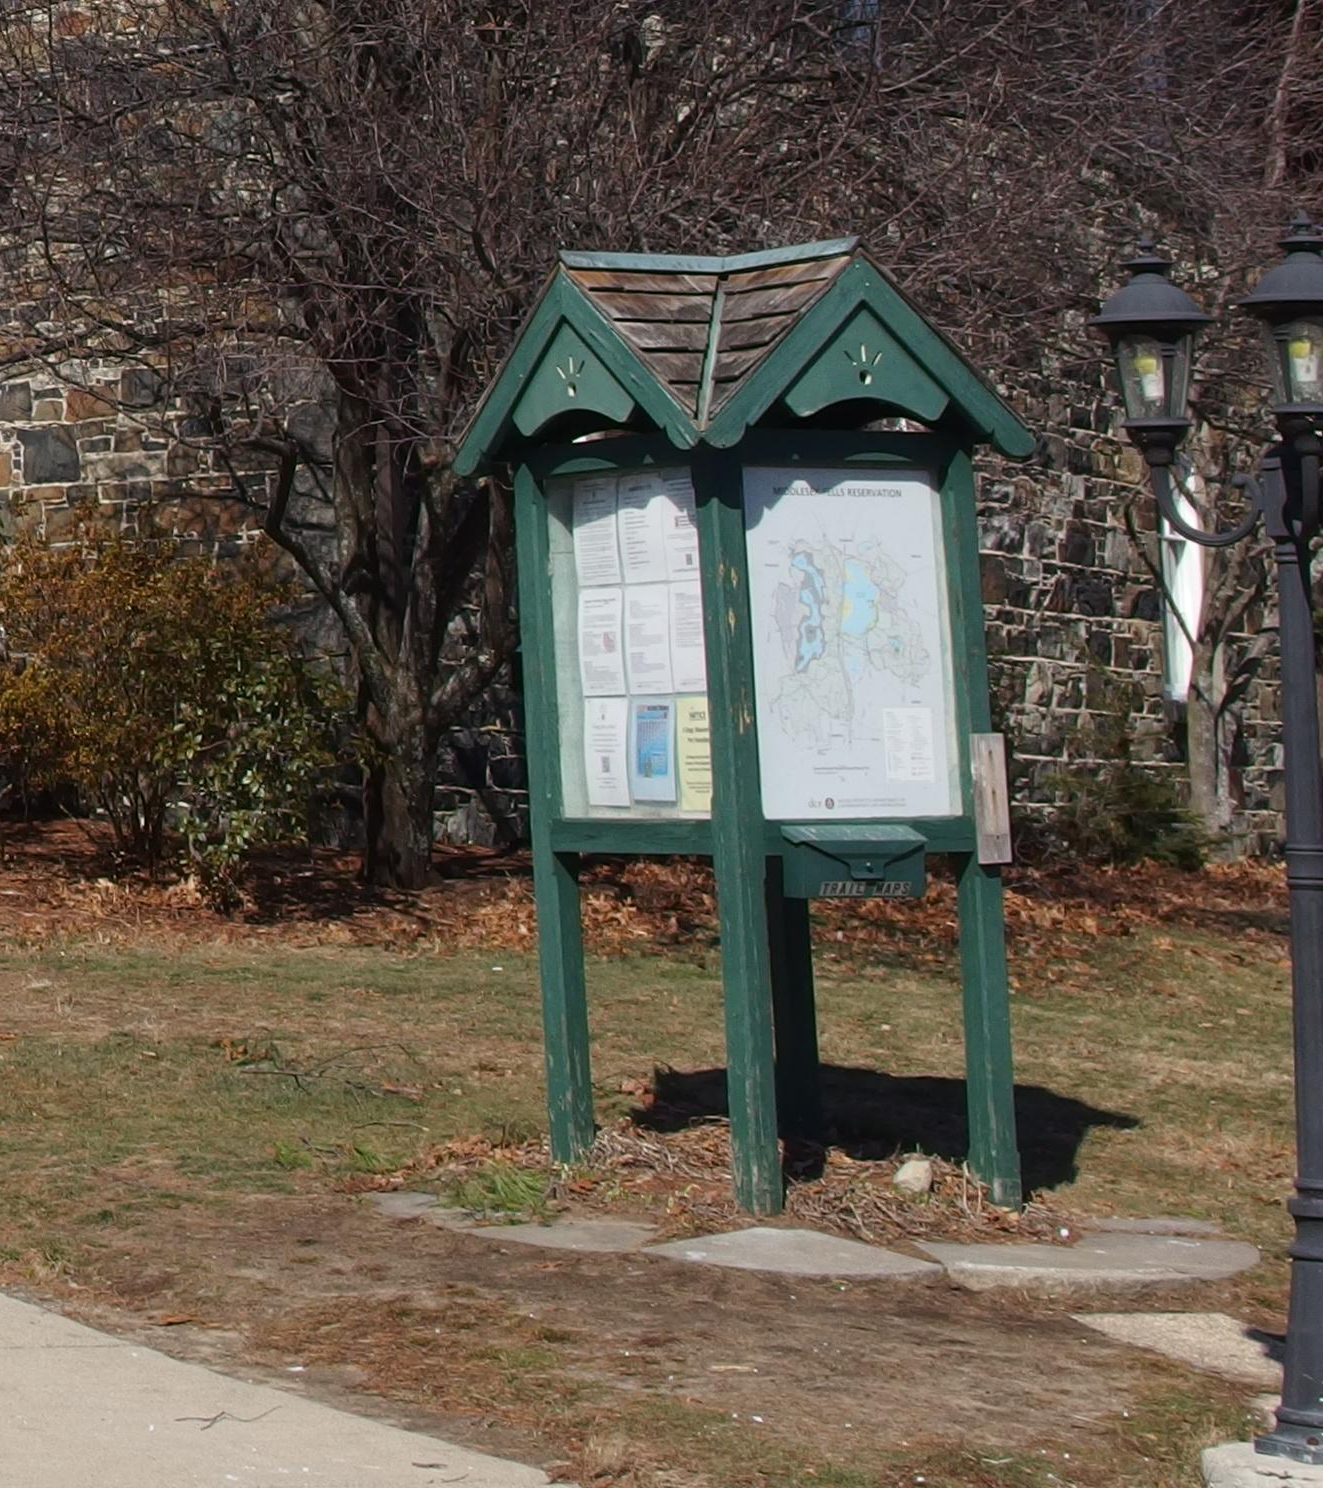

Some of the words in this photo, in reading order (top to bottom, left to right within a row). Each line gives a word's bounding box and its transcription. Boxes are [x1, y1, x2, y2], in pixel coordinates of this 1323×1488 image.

[847, 487, 902, 498] RESERVATION
[821, 882, 865, 896] TRAIL
[874, 882, 911, 896] MAPS
